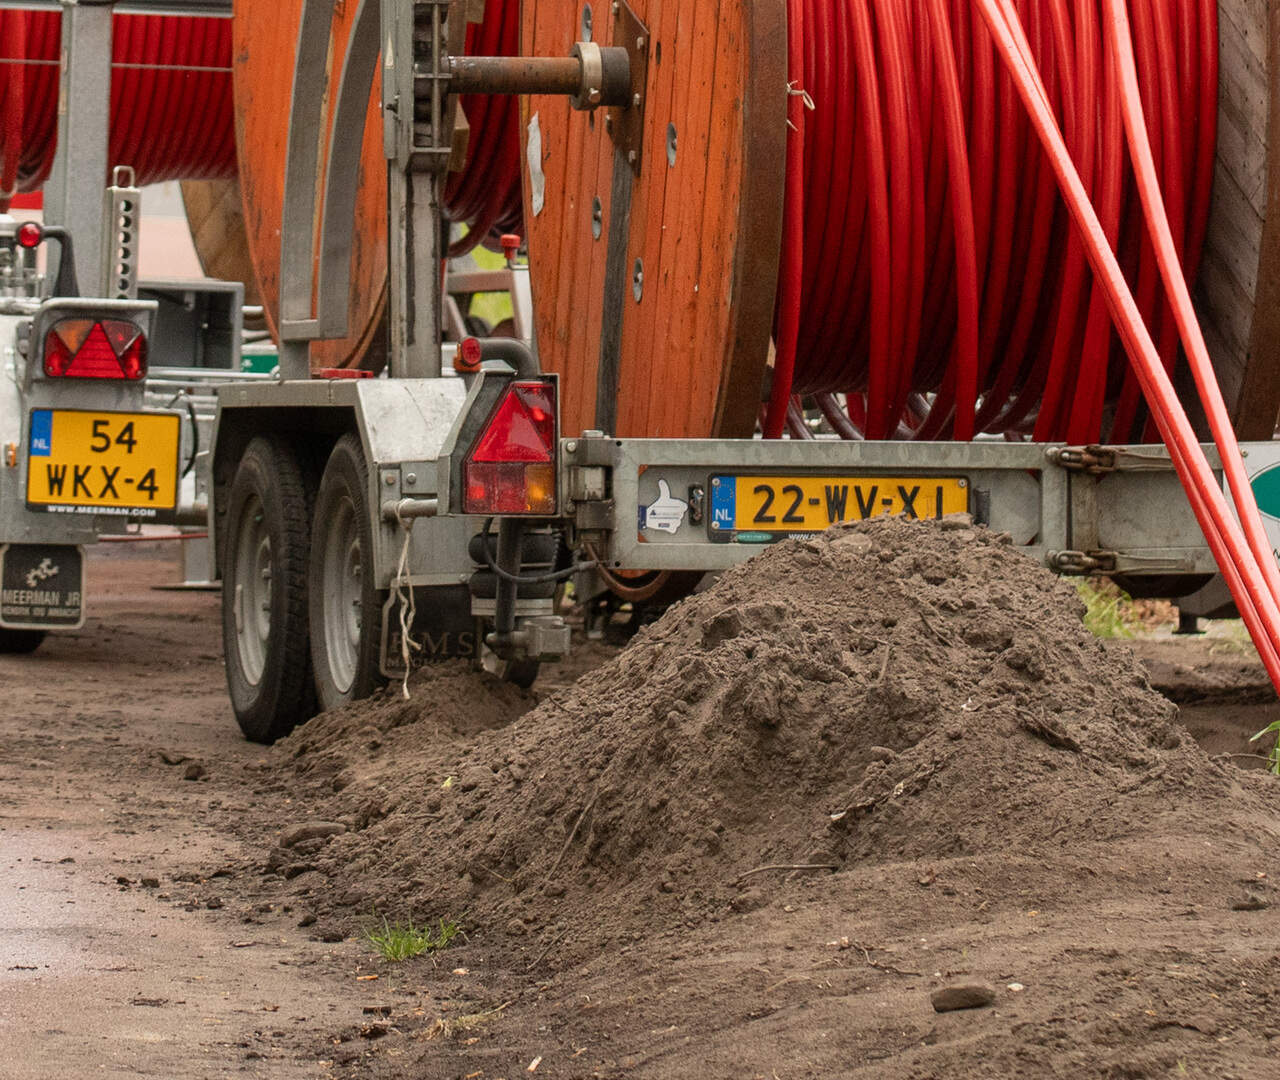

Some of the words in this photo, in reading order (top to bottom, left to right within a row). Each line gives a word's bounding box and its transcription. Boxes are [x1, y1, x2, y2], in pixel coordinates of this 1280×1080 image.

[33, 438, 49, 449] NL
[91, 420, 137, 454] 54
[47, 464, 159, 500] WKX-4
[48, 505, 156, 517] WWW.MEERMAN.COM
[715, 509, 732, 521] NL
[2, 589, 60, 606] MEERMAN
[65, 592, 80, 606] JR
